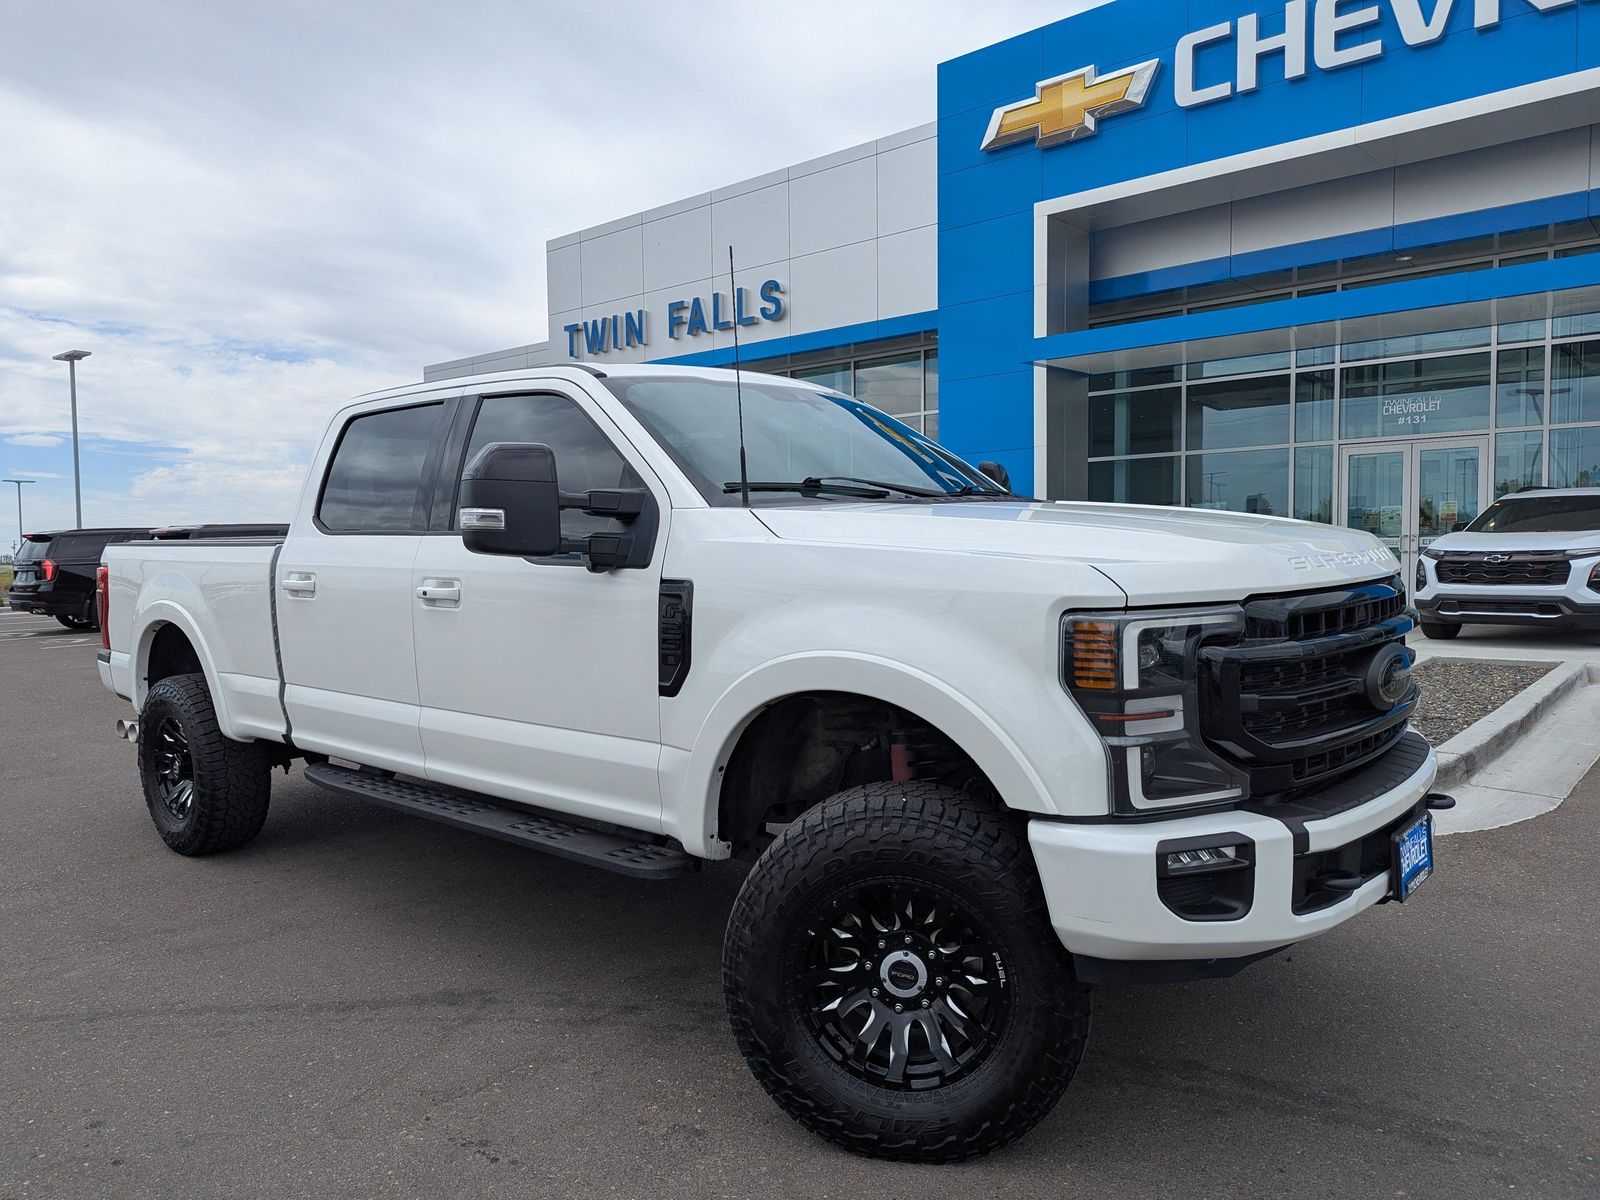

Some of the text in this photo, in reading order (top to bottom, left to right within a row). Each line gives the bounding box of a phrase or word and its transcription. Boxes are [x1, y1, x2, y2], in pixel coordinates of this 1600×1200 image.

[564, 279, 785, 358] TWIN FALLS
[1383, 401, 1441, 415] CHEVROLET
[1398, 415, 1427, 425] #131
[992, 952, 1005, 988] FUEL
